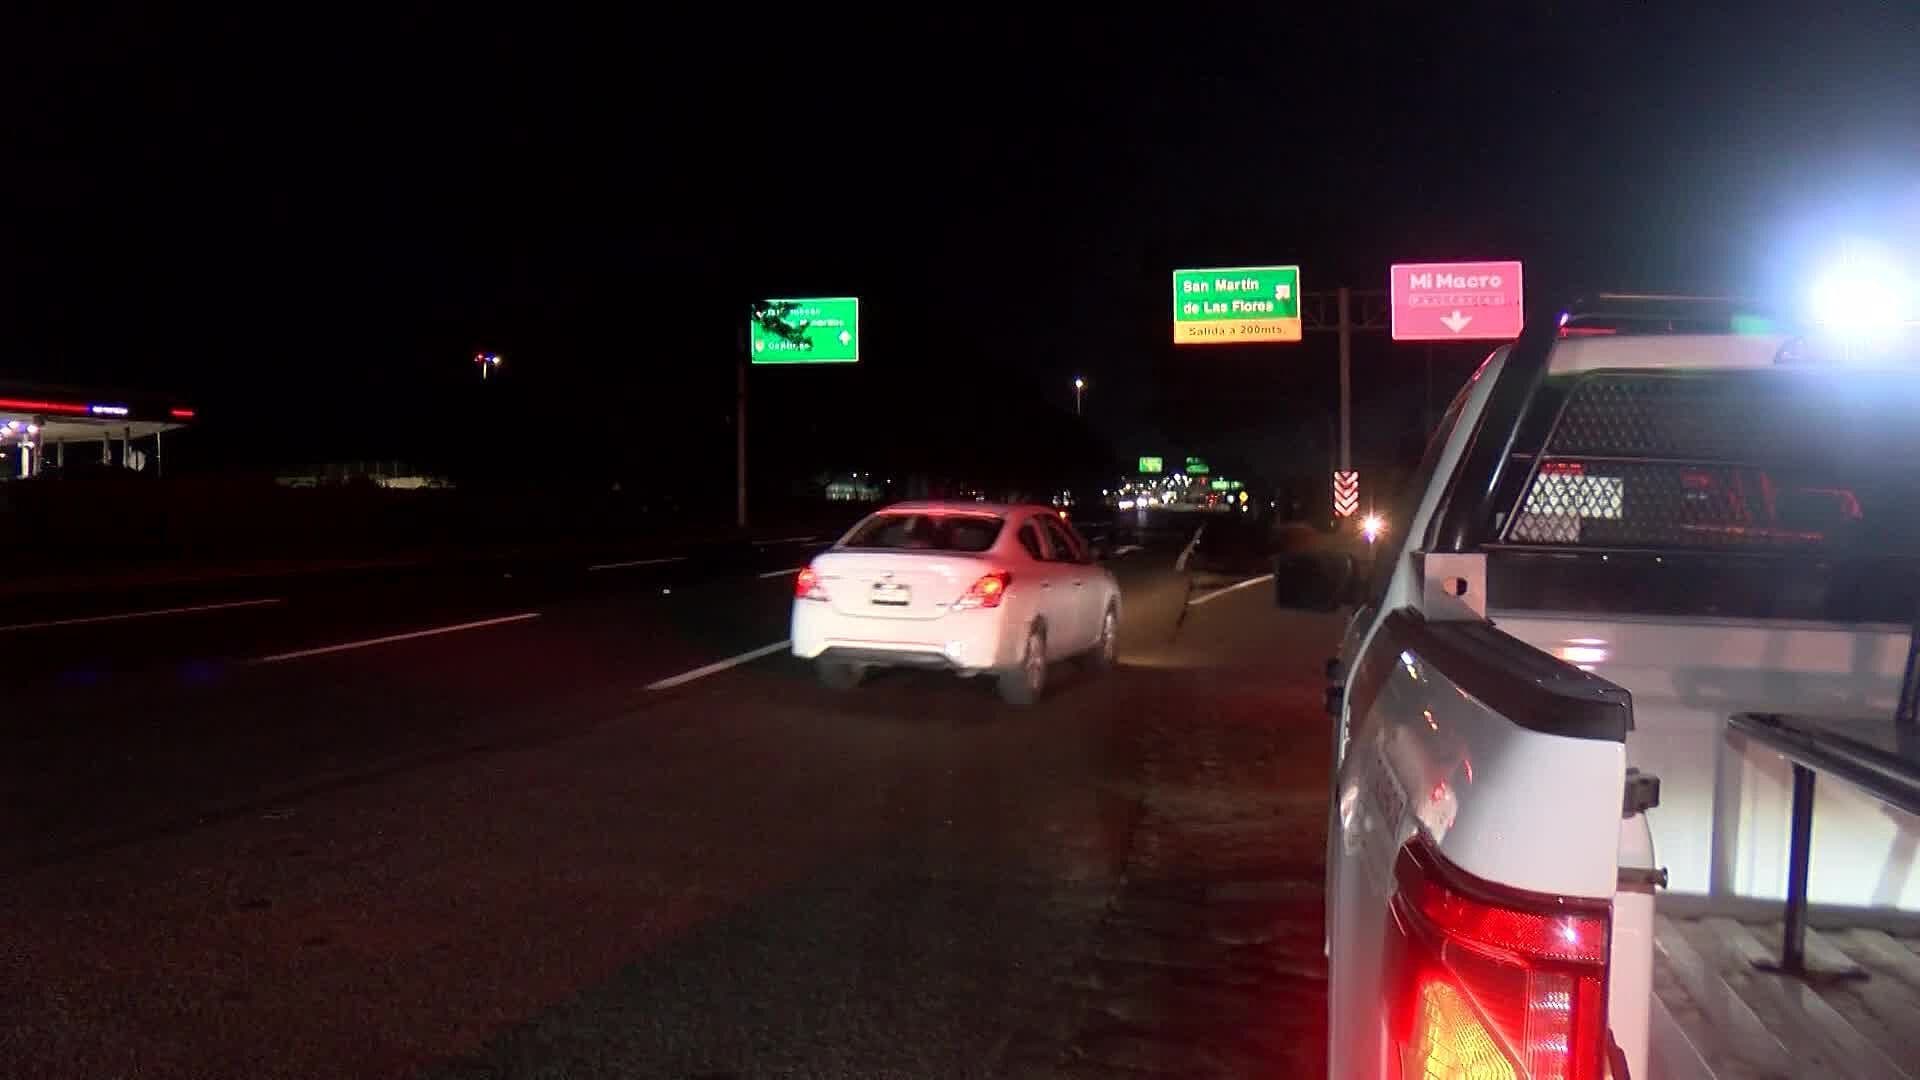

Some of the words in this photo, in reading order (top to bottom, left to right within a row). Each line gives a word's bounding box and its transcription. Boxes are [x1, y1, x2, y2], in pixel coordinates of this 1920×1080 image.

[1183, 281, 1208, 293] San
[1409, 273, 1432, 289] Mi
[1436, 273, 1502, 289] Macro
[1184, 302, 1199, 314] de
[1203, 301, 1228, 314] Las
[1232, 300, 1274, 312] Flores
[1189, 327, 1225, 336] Salida
